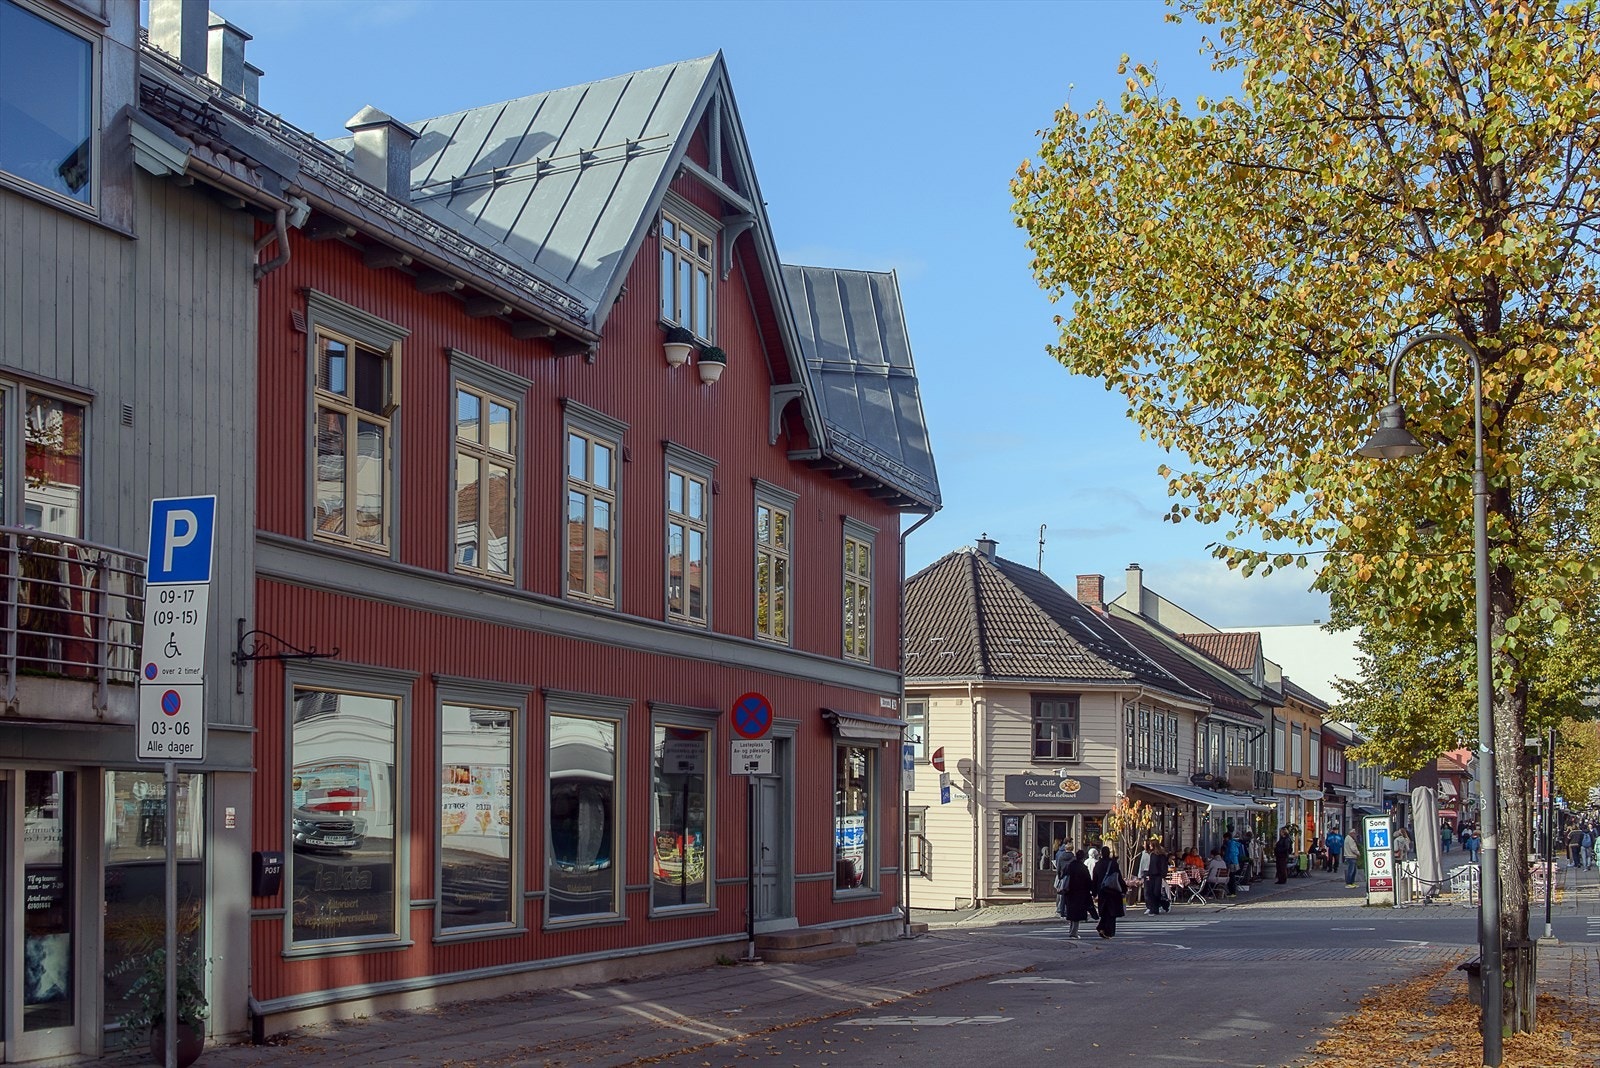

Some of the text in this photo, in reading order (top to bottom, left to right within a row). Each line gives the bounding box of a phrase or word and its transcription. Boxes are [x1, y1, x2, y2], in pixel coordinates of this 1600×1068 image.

[163, 509, 198, 572] P
[160, 589, 195, 604] 09-17
[153, 609, 198, 627] (09-15)
[178, 667, 182, 675] 2
[184, 667, 200, 675] timer
[151, 721, 190, 735] 03-06
[147, 740, 194, 755] Alle dager
[264, 866, 280, 874] POST
